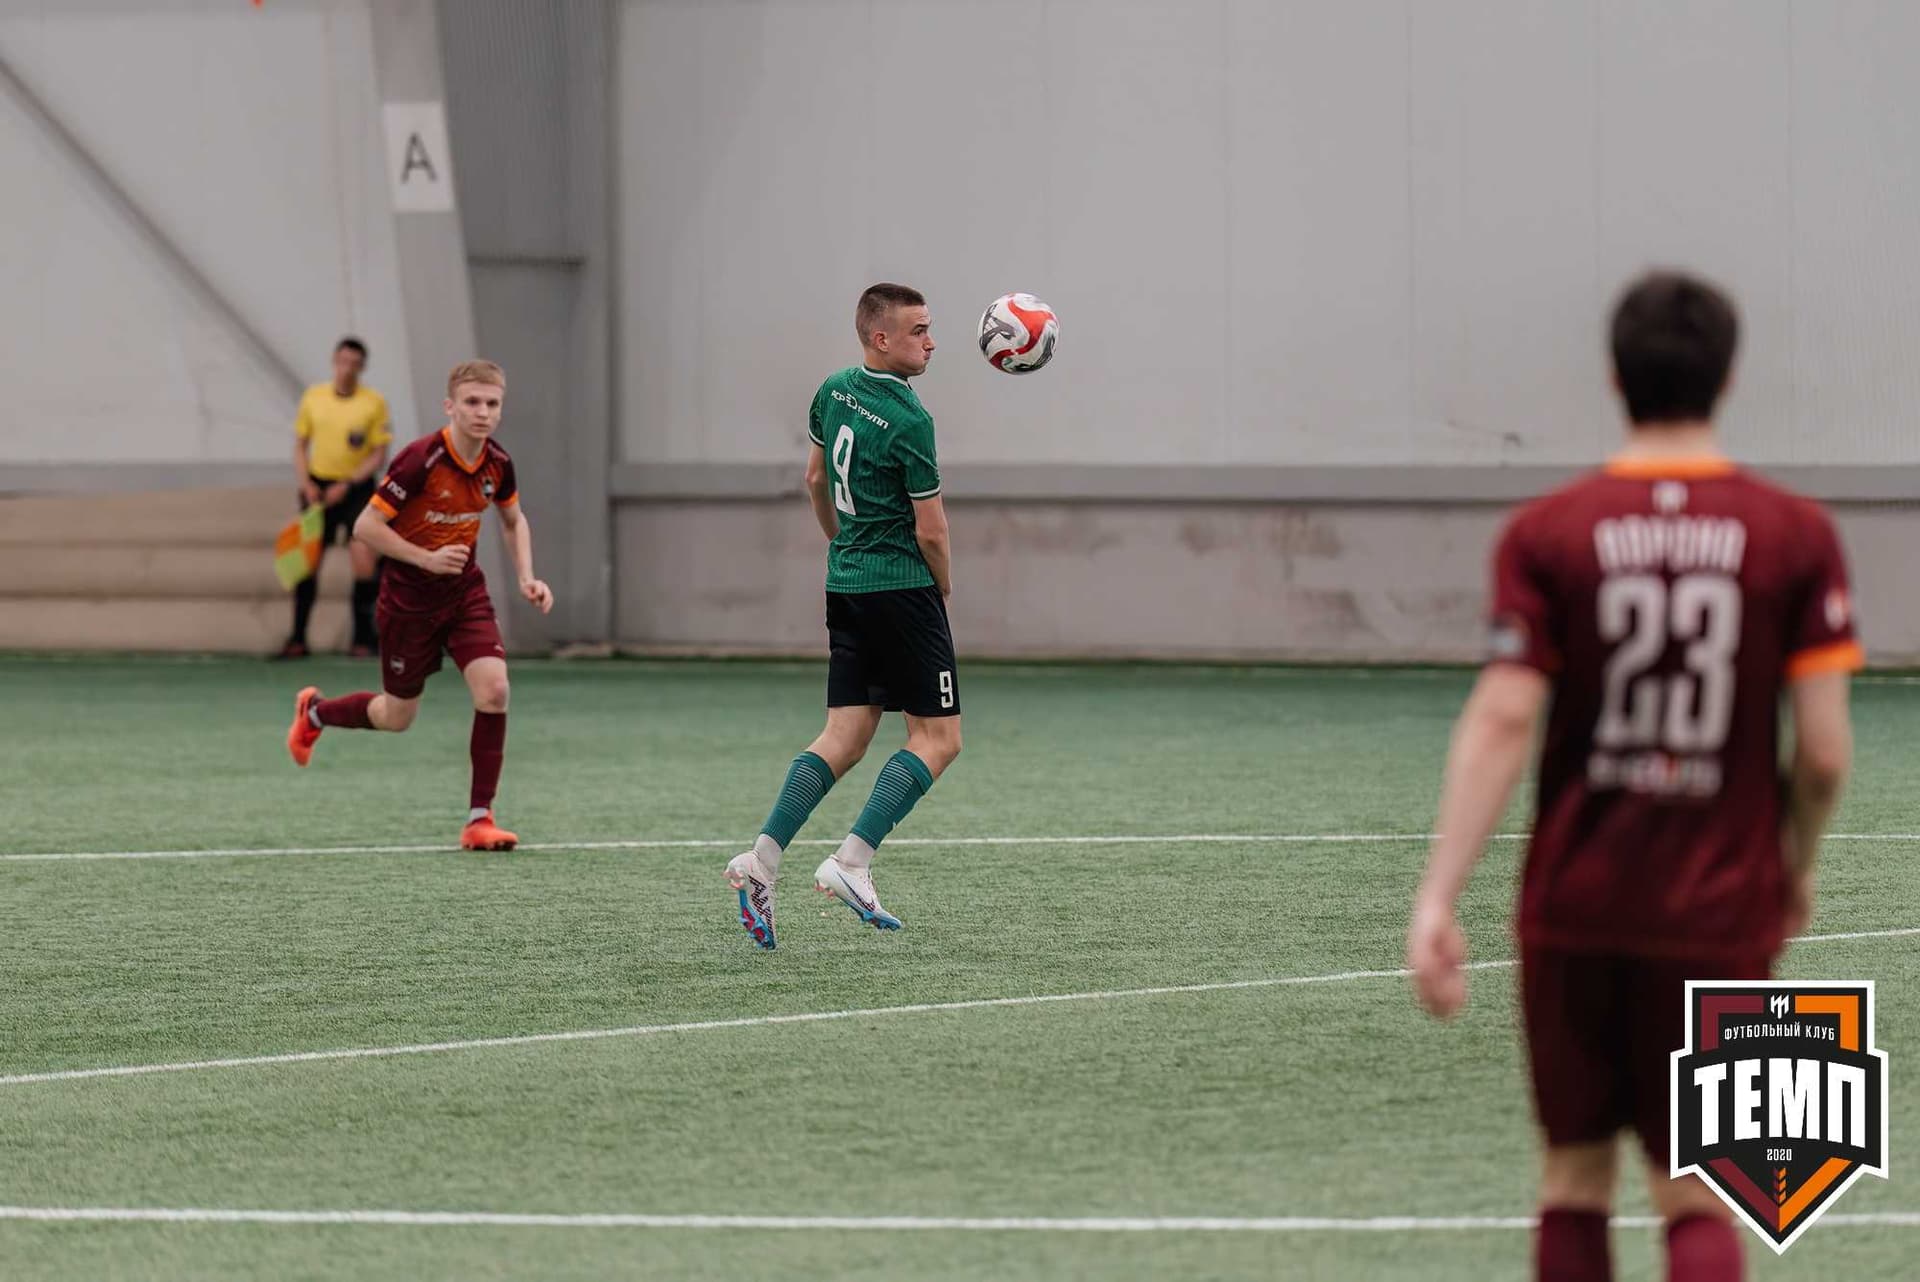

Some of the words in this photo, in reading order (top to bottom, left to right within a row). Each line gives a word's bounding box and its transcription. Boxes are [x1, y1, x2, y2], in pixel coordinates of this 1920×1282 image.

[833, 424, 856, 515] 9
[939, 670, 954, 708] 9
[1594, 574, 1742, 751] 23
